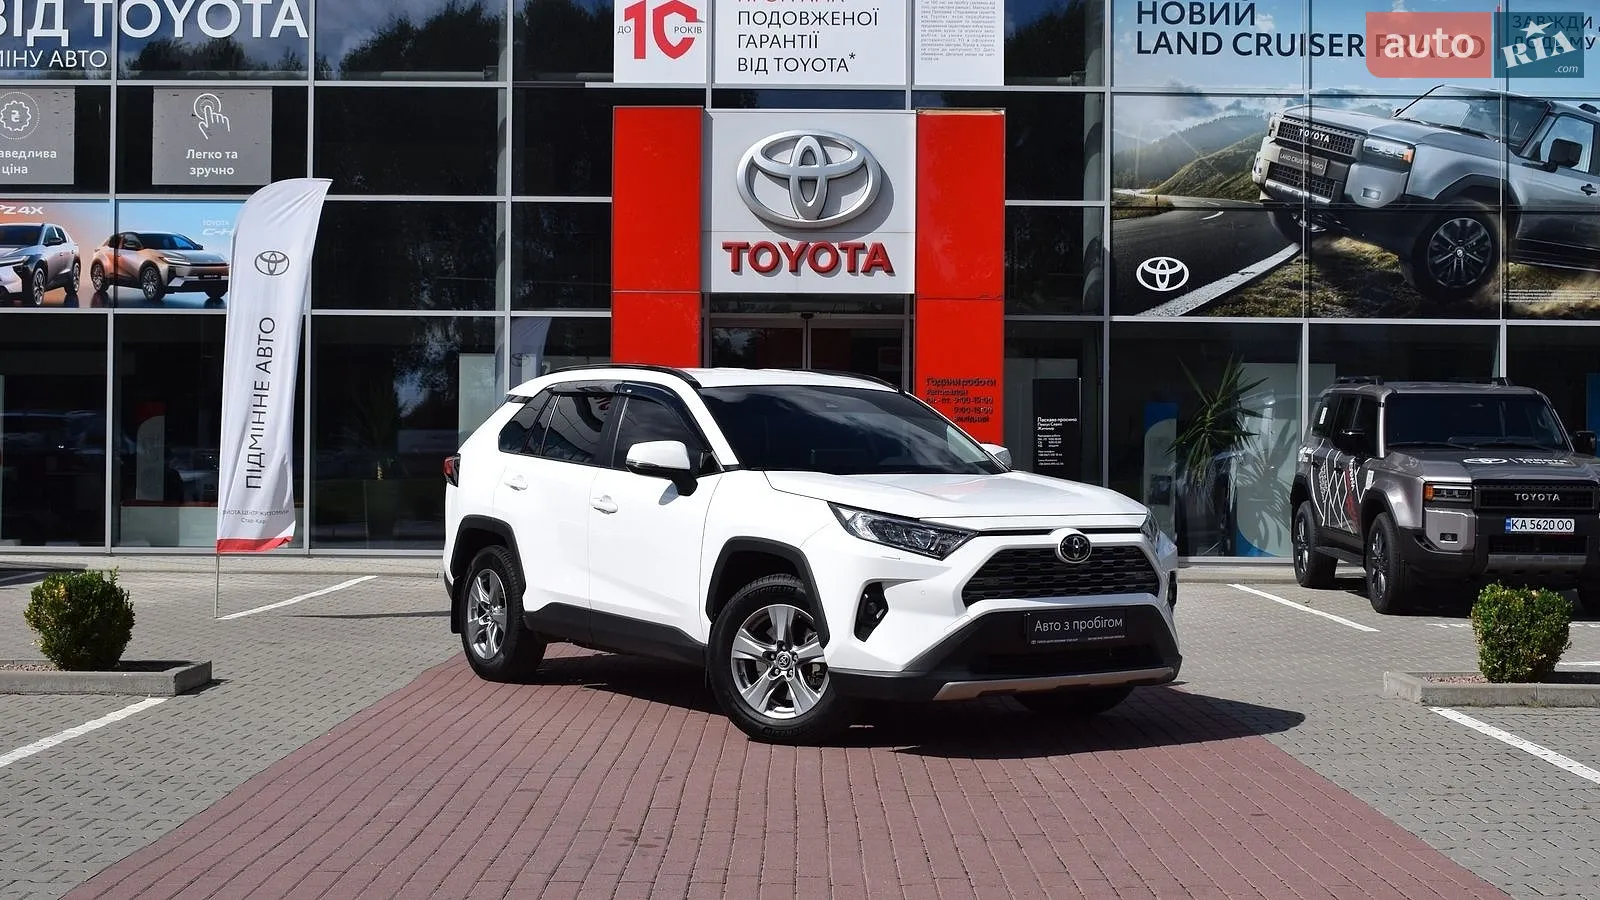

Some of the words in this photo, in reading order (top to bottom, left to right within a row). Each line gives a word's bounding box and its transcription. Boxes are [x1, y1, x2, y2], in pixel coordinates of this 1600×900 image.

[738, 8, 879, 28] ПОДОВЖЕНОЇ
[617, 26, 631, 34] ДО
[674, 26, 702, 34] РОКІВ
[738, 31, 820, 48] ГАРАНТІЇ
[1137, 31, 1223, 55] LAND
[1233, 32, 1366, 57] CRUISER
[0, 50, 43, 67] ІНУ
[49, 50, 107, 68] АВТО
[738, 57, 768, 75] ВІД
[186, 149, 222, 159] Легко
[225, 151, 238, 159] та
[2, 164, 28, 175] ціна
[189, 167, 235, 177] зручно
[721, 241, 896, 274] TOYOTA
[255, 317, 276, 375] АВТО
[246, 381, 270, 489] ПІДМІННЕ
[1514, 493, 1560, 502] TOYOTA
[1511, 519, 1527, 530] KA
[1530, 519, 1555, 530] 5620
[1034, 620, 1061, 632] Авто
[1064, 621, 1070, 630] з
[1072, 616, 1123, 632] пробігом
